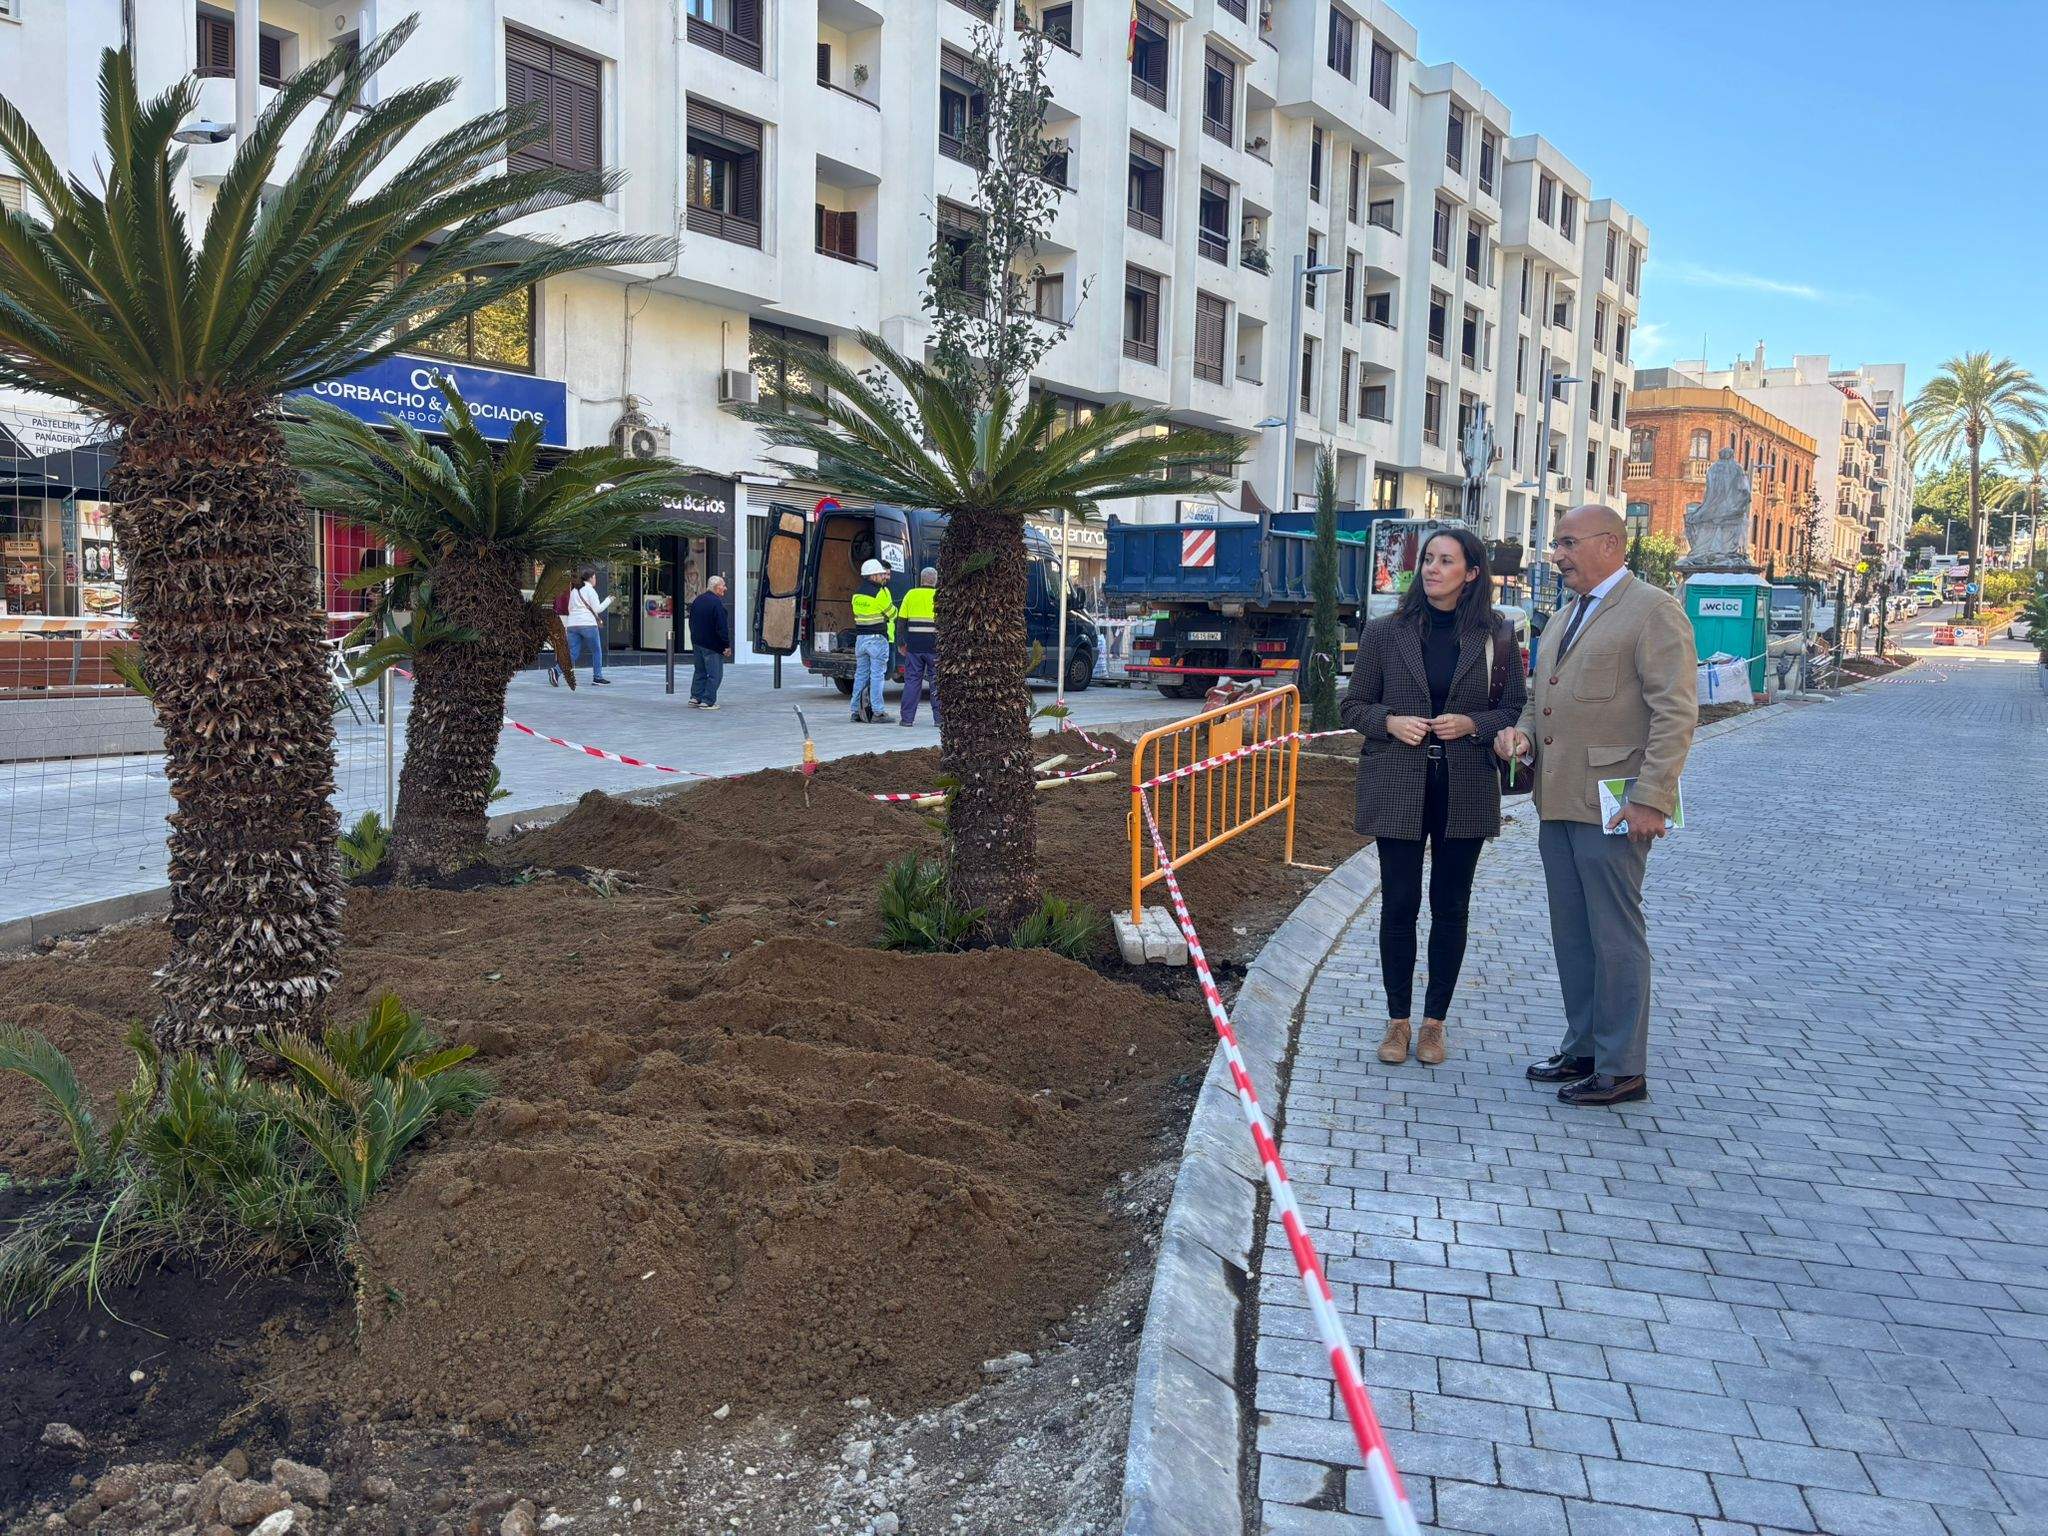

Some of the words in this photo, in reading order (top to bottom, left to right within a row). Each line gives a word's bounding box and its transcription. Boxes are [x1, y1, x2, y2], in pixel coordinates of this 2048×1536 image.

[313, 381, 425, 409] CORBACHO
[428, 396, 442, 411] &
[444, 402, 544, 425] OCIADOS
[683, 494, 725, 513] Baños
